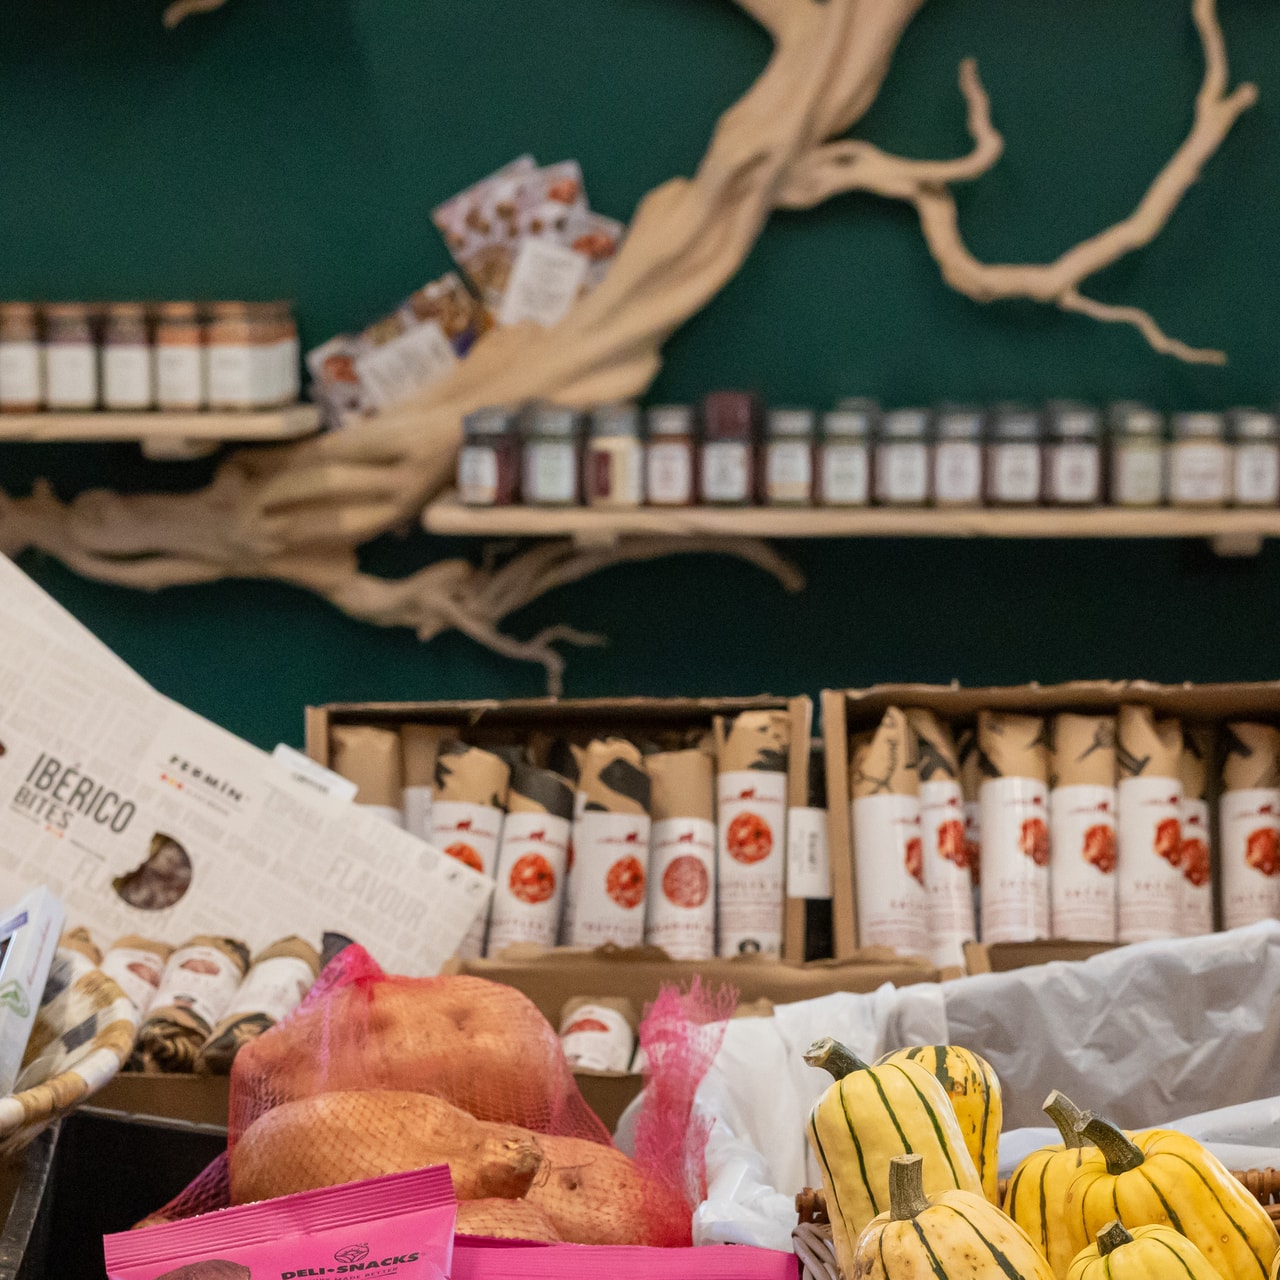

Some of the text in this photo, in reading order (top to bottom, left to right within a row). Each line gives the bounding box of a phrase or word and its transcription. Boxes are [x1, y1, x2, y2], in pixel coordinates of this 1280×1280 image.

[13, 785, 76, 831] BITES
[25, 752, 137, 833] IBÉRICO
[364, 1267, 398, 1279] BETTER
